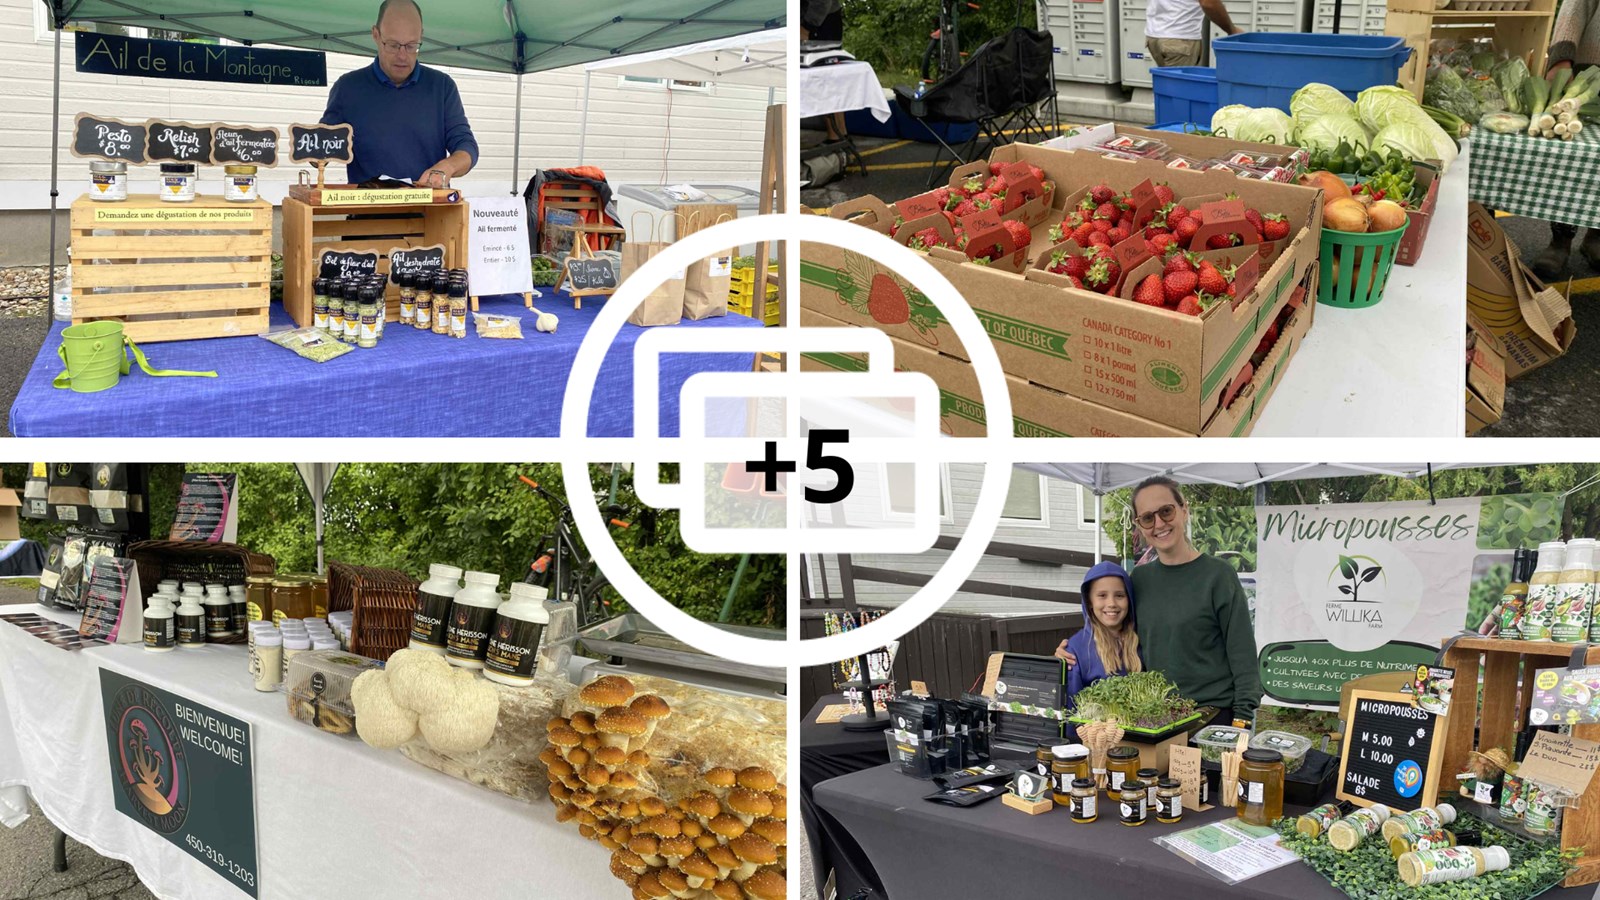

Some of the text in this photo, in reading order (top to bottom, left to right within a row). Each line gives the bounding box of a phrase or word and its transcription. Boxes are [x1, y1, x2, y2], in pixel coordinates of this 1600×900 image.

[81, 38, 292, 83] Ail de la Montagne
[294, 76, 320, 86] Rigaud
[95, 125, 132, 144] Pesto
[158, 128, 200, 147] Relish
[297, 133, 345, 154] Ail noir
[327, 193, 339, 201] Ail
[362, 192, 403, 203] dégustation
[404, 193, 431, 203] gratuite
[97, 211, 139, 219] Demandez
[156, 210, 197, 222] dégustation
[223, 210, 252, 220] produits
[473, 208, 519, 218] Nouveauté
[477, 225, 517, 233] Ail fermenté
[1471, 219, 1491, 243] Dole
[393, 252, 405, 265] Ail
[1490, 256, 1514, 284] BANAN
[993, 322, 1007, 336] OF
[1009, 325, 1054, 350] QUÉBEC
[1083, 317, 1171, 349] CANADA CATEGORY No 1
[1094, 338, 1103, 347] 10
[1111, 341, 1115, 350] 1
[1116, 343, 1132, 356] litre
[1505, 331, 1539, 364] PREMIUM
[1094, 353, 1099, 362] 8
[1106, 356, 1110, 365] 1
[1113, 360, 1136, 373] pound
[1095, 369, 1104, 378] 15
[1111, 373, 1125, 386] 500
[1126, 379, 1136, 389] ml
[1095, 383, 1104, 392] 12
[1111, 388, 1125, 399] 750
[1126, 393, 1136, 403] ml
[1263, 509, 1474, 549] Micropousses
[460, 636, 479, 645] MANE
[501, 652, 522, 661] MANE
[1312, 658, 1329, 666] 40X
[1332, 659, 1357, 667] PLUS
[1361, 660, 1373, 668] DE
[1377, 662, 1418, 672] NUTRIME
[1273, 668, 1320, 678] CULTIVÉES
[1322, 671, 1347, 680] AVEC
[1273, 680, 1289, 688] DES
[1292, 682, 1332, 692] SAVEURS
[1361, 701, 1429, 720] MICROPOUSSES
[175, 703, 246, 745] BIENVENUE!
[180, 725, 243, 765] WELCOME!
[1362, 732, 1393, 747] M 5.00
[1360, 748, 1394, 764] L 10.00
[1347, 771, 1380, 790] SALADE
[1355, 786, 1366, 795] 6$
[160, 805, 186, 830] MOON
[185, 833, 255, 887] 450-319-1203
